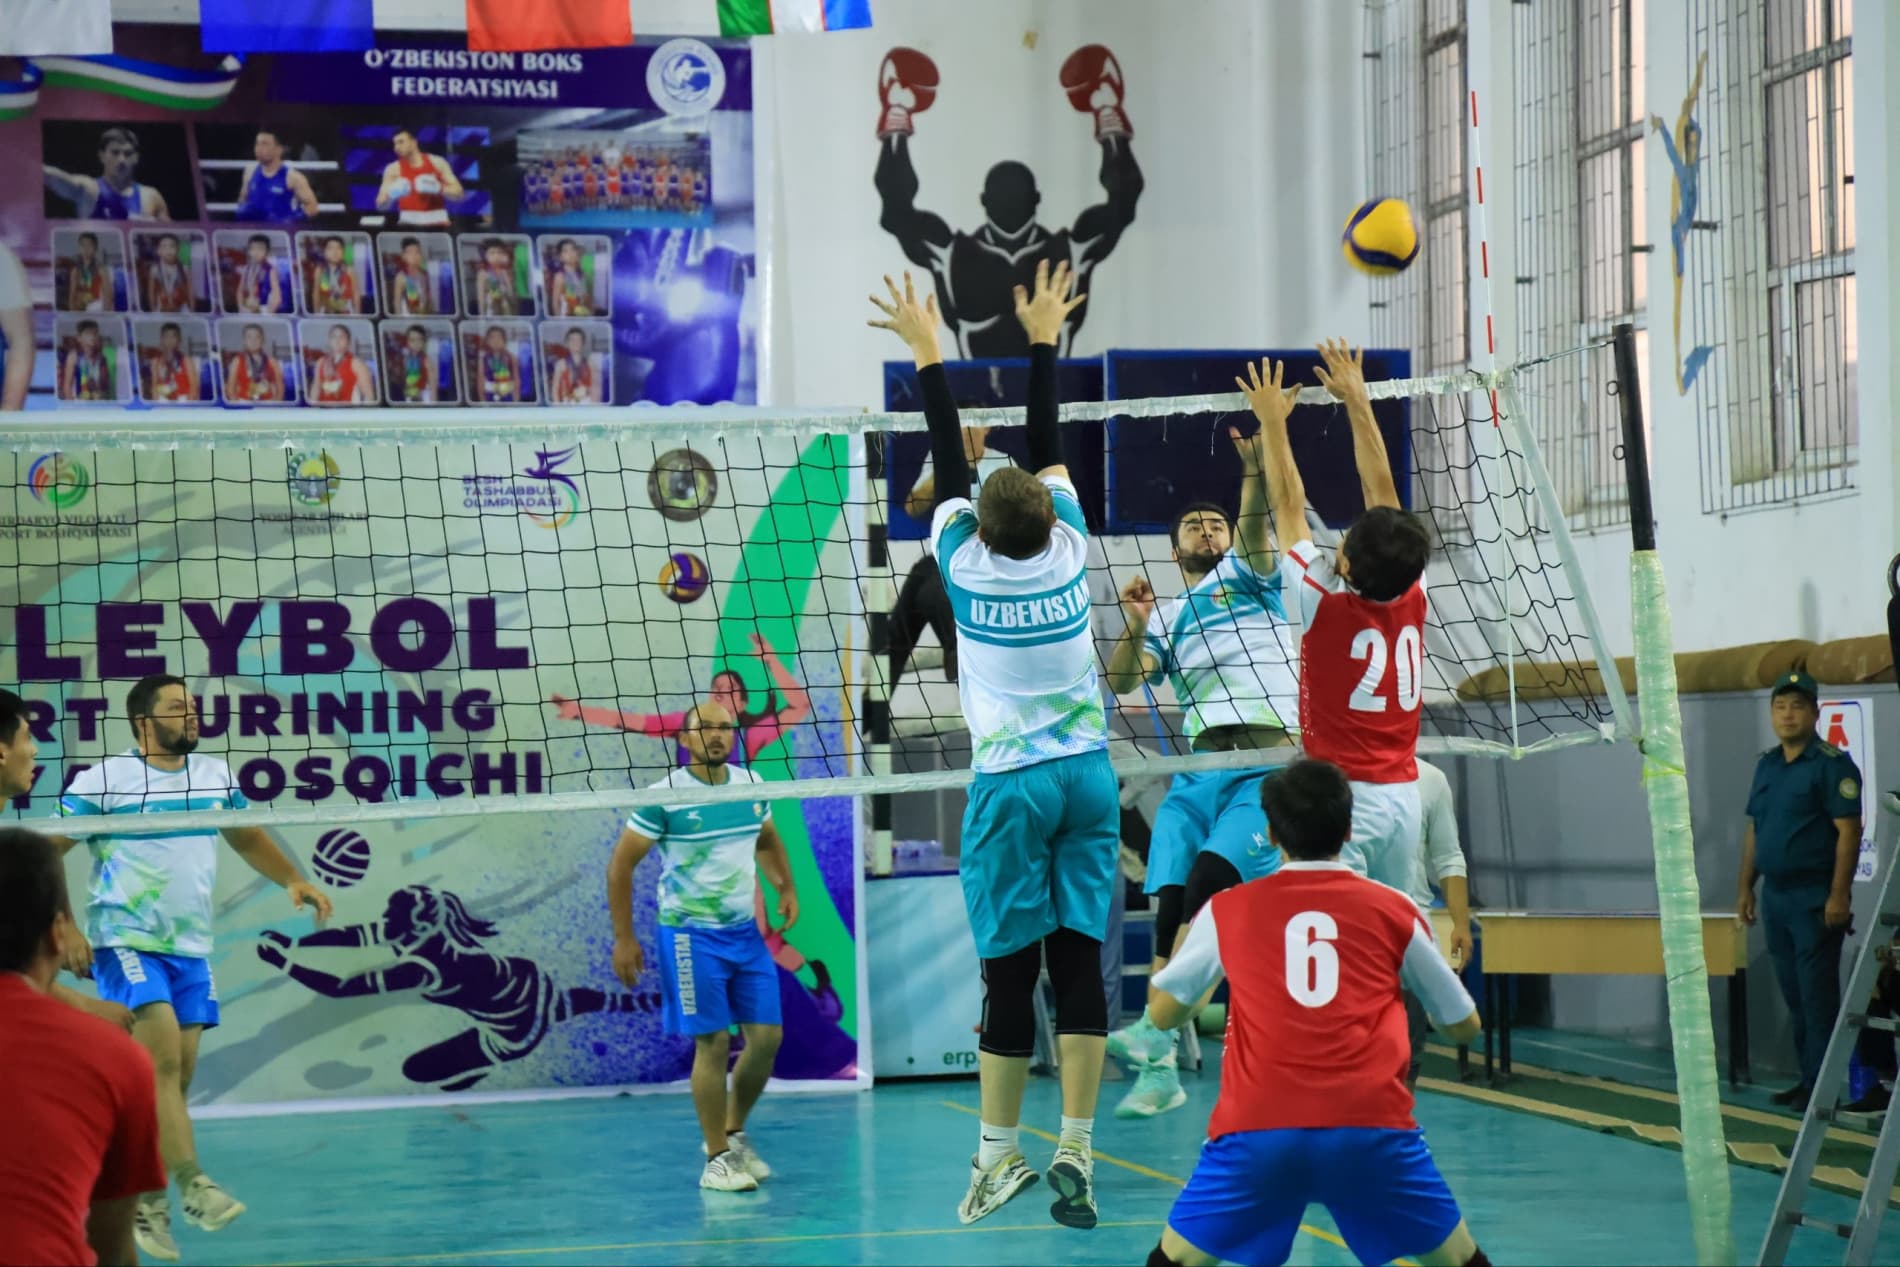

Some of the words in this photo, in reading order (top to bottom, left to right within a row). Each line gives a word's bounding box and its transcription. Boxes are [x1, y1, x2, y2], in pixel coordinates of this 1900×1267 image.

[522, 53, 583, 72] BOKS
[391, 77, 558, 98] FEDERATSIYASI
[463, 475, 503, 484] BESH
[463, 486, 557, 496] TASHABBUS
[463, 498, 562, 508] OLIMPIADASI
[1348, 624, 1422, 712] 20
[26, 697, 109, 743] RT
[192, 688, 495, 738] URINING
[237, 752, 542, 803] OSQICHI
[1285, 911, 1340, 1008] 6
[674, 933, 697, 1016] UZBEKISTAN
[943, 1051, 979, 1069] erp
